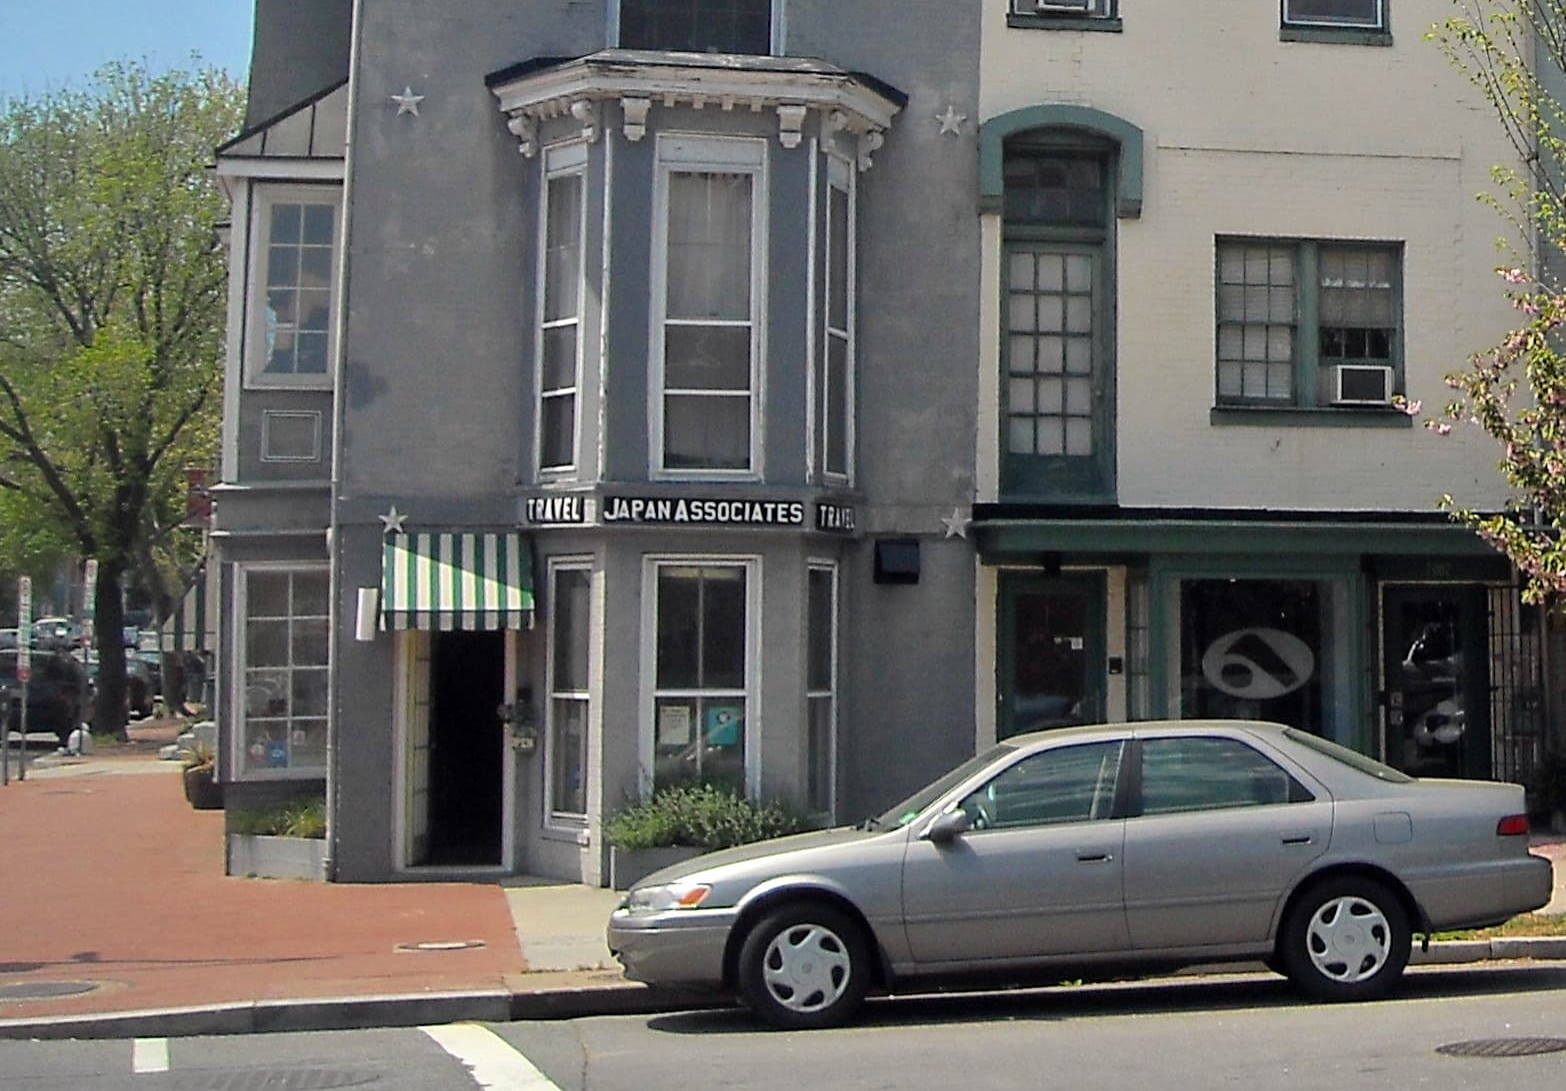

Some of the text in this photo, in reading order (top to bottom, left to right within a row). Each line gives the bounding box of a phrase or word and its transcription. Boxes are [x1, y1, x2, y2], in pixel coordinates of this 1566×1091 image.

[527, 497, 580, 520] TRAVEL
[604, 498, 803, 523] JAPAN ASSOCIATES
